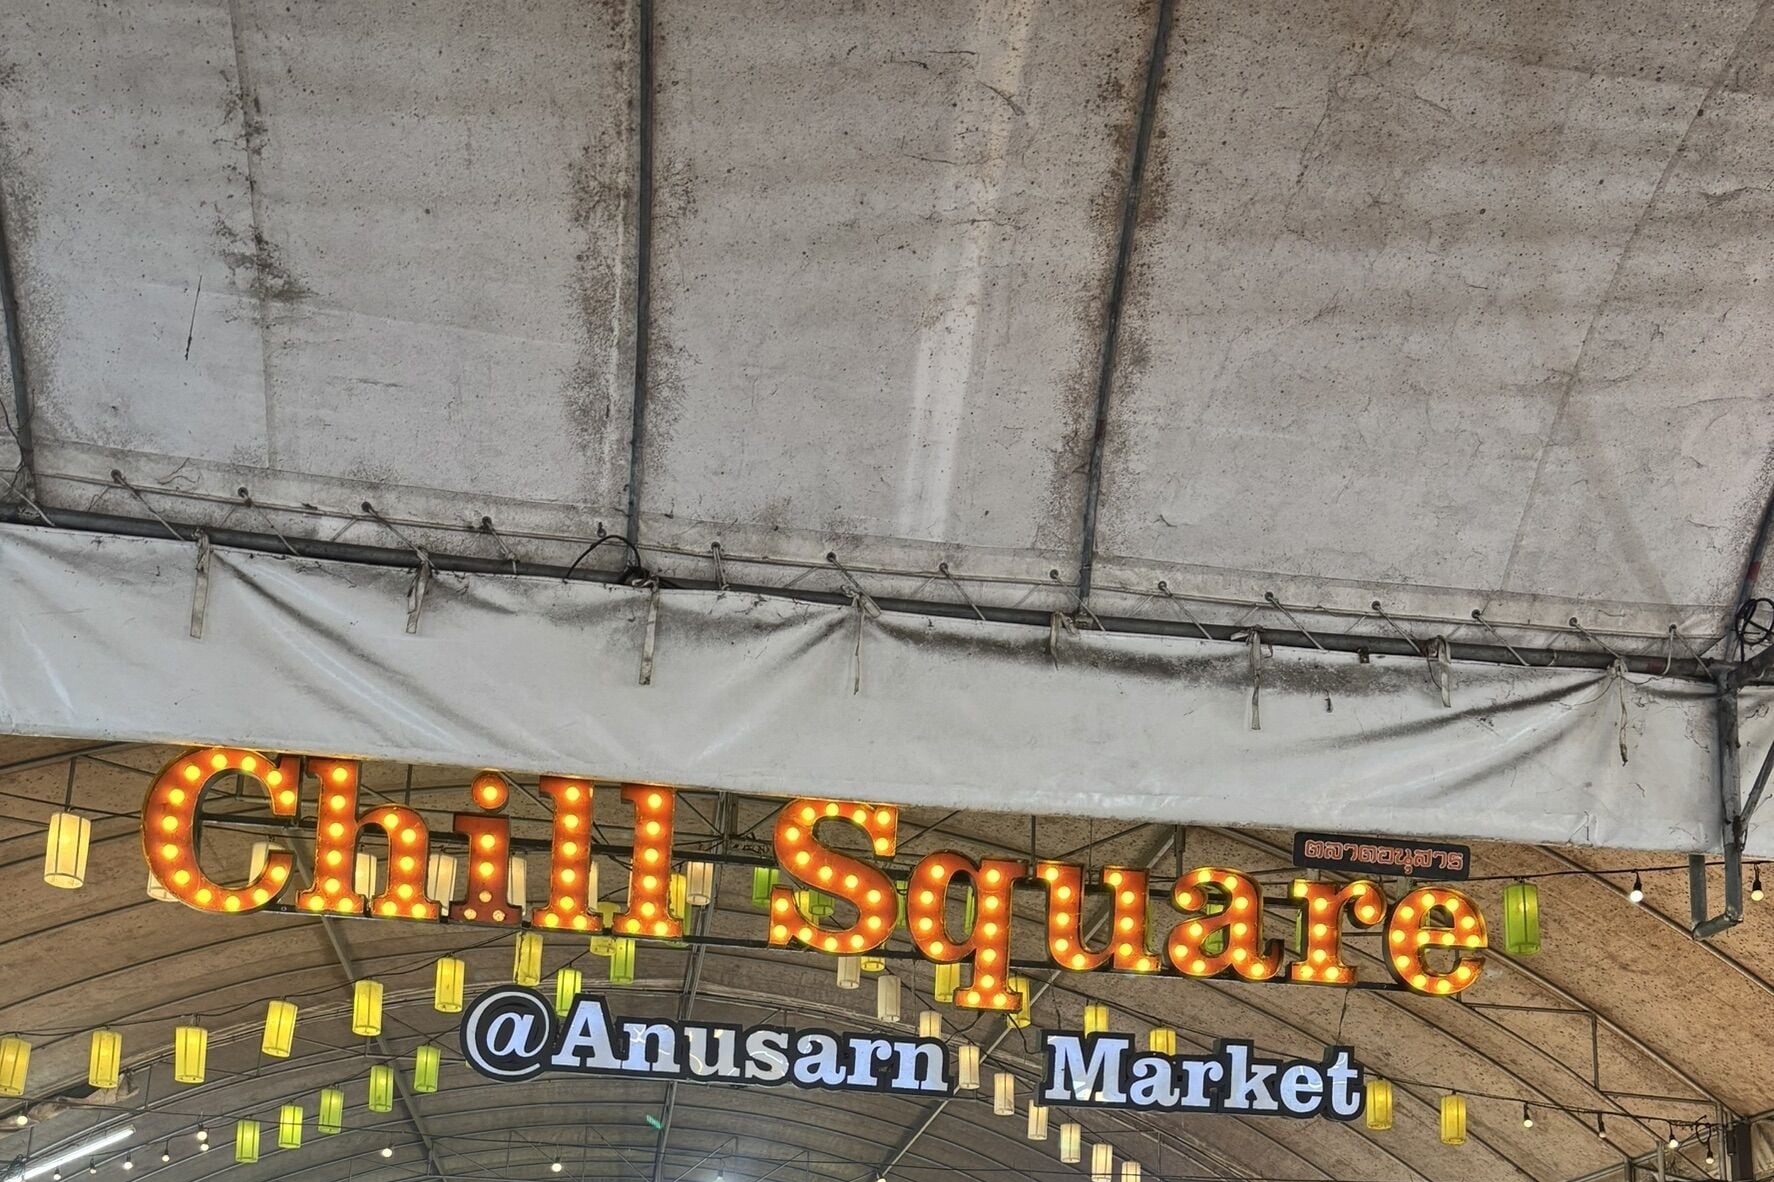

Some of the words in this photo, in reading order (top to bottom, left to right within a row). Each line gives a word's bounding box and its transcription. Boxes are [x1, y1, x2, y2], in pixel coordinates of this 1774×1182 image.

[143, 747, 684, 940] Chill
[770, 796, 1490, 1012] Square
[1304, 839, 1464, 875] ตลาดอนุสาร
[465, 989, 951, 1096] @Anusarn
[1043, 1030, 1365, 1118] Market
